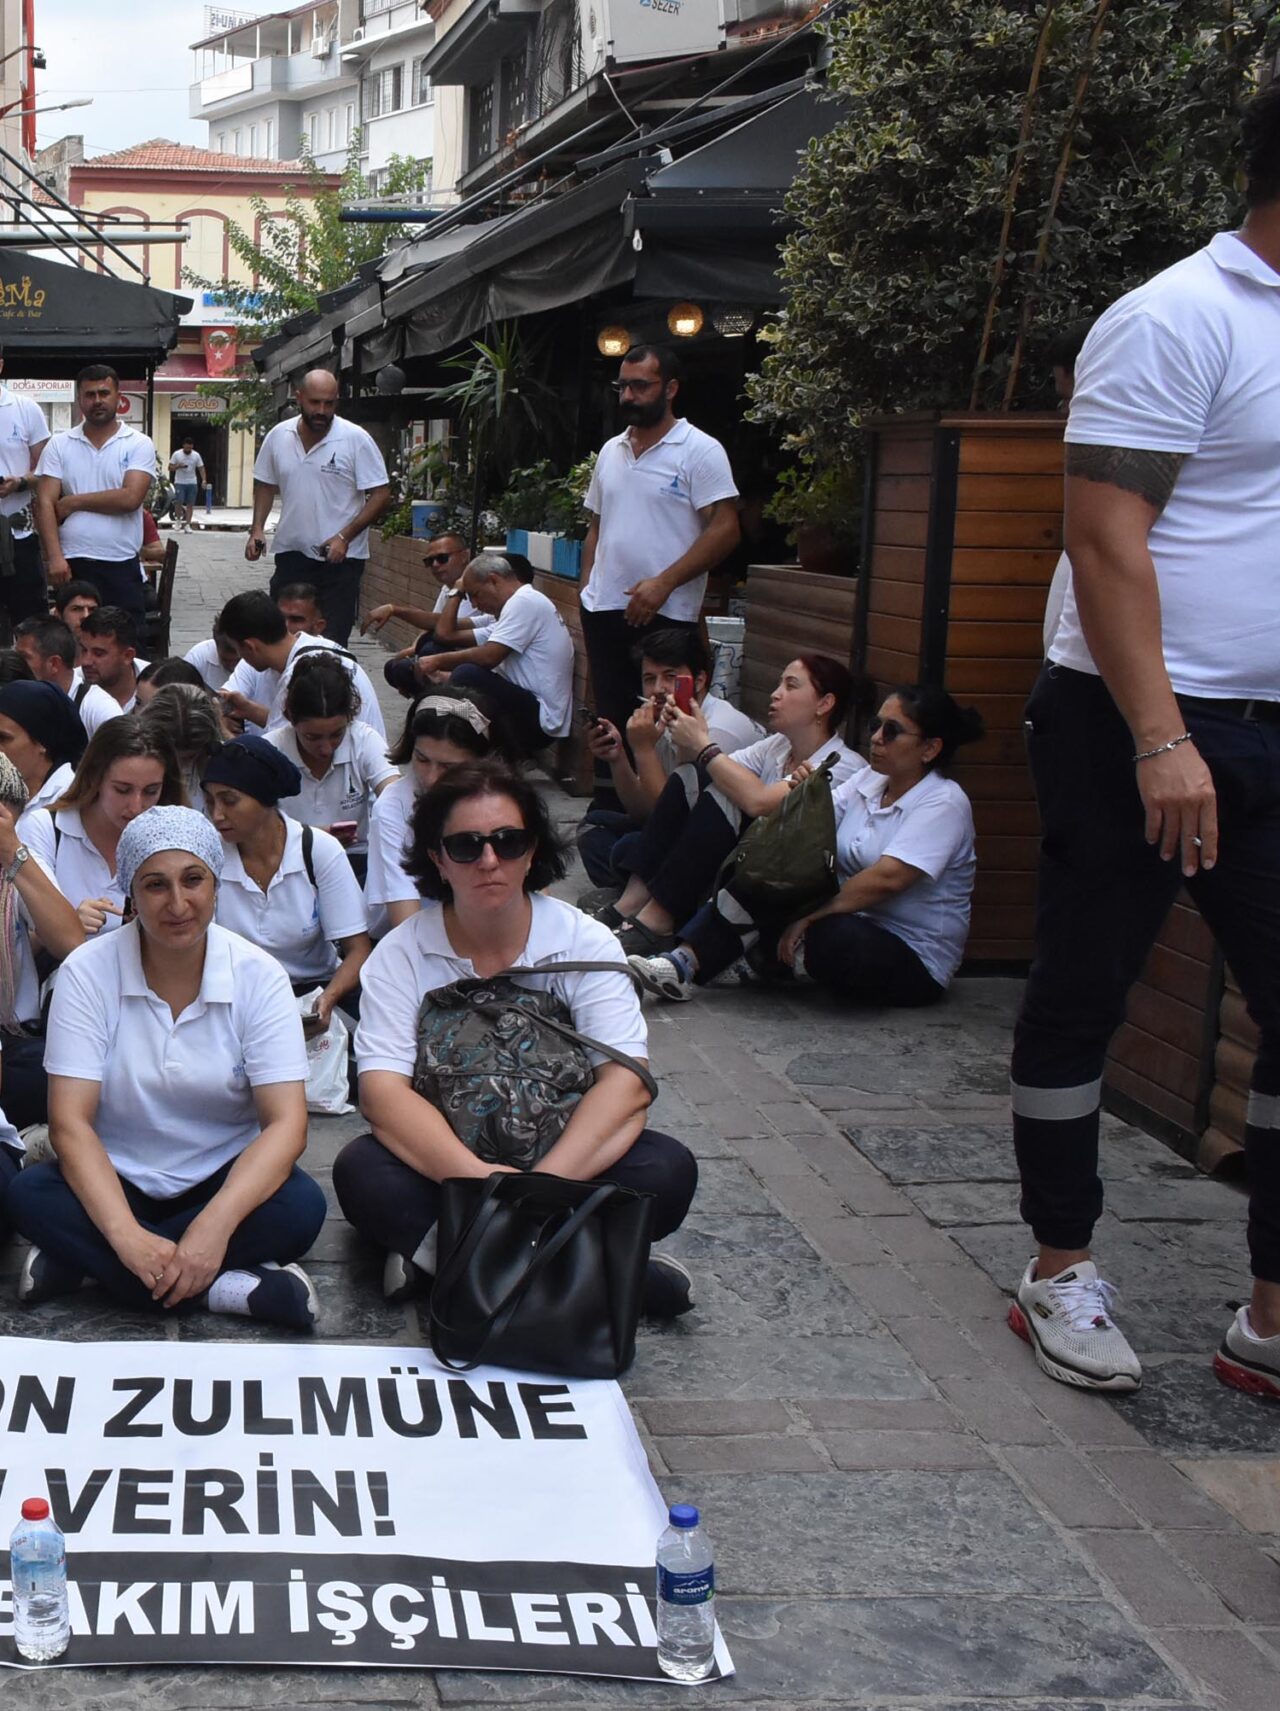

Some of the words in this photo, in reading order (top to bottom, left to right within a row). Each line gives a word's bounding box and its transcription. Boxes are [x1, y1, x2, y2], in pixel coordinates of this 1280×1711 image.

[103, 1366, 589, 1440] ZULMÜNE
[44, 1452, 397, 1538] VERİN!
[289, 1569, 658, 1651] İŞÇİLERİ
